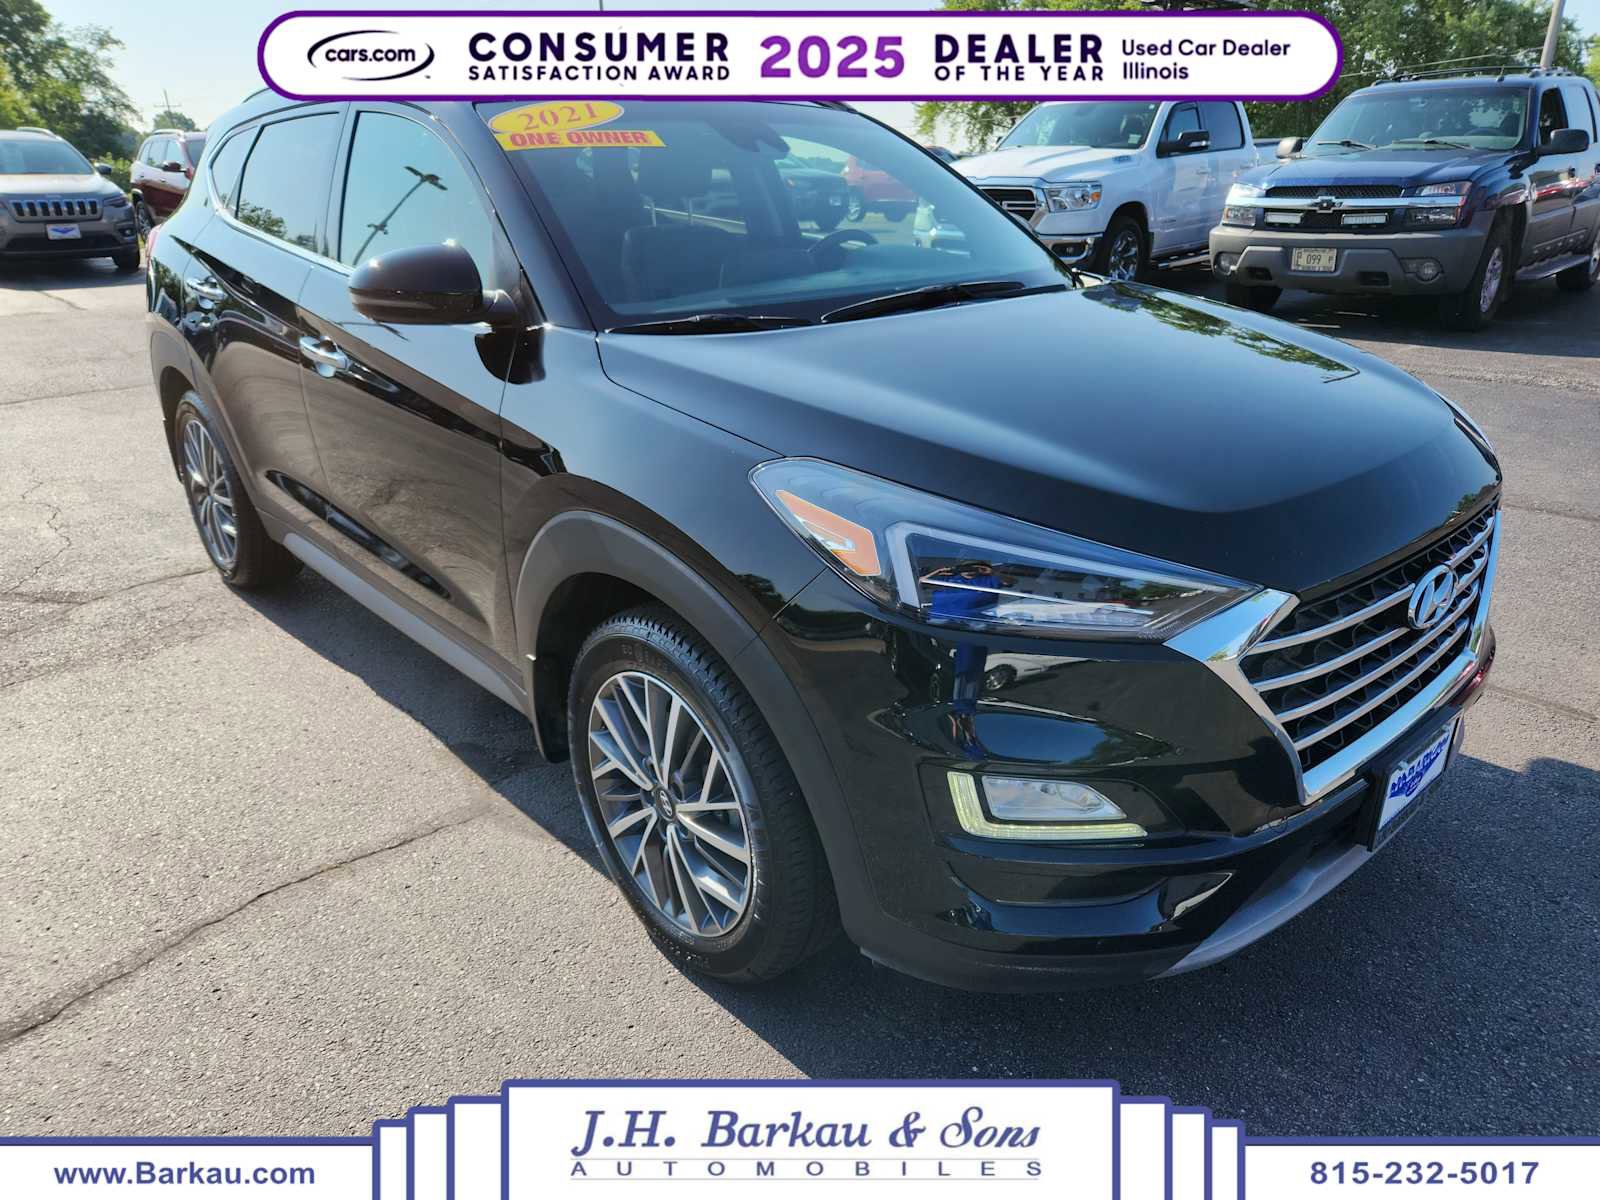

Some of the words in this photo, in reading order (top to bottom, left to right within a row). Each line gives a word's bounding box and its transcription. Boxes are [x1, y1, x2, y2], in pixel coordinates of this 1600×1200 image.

[518, 103, 598, 130] 2021
[509, 133, 562, 147] ONE
[566, 131, 647, 145] OWNER
